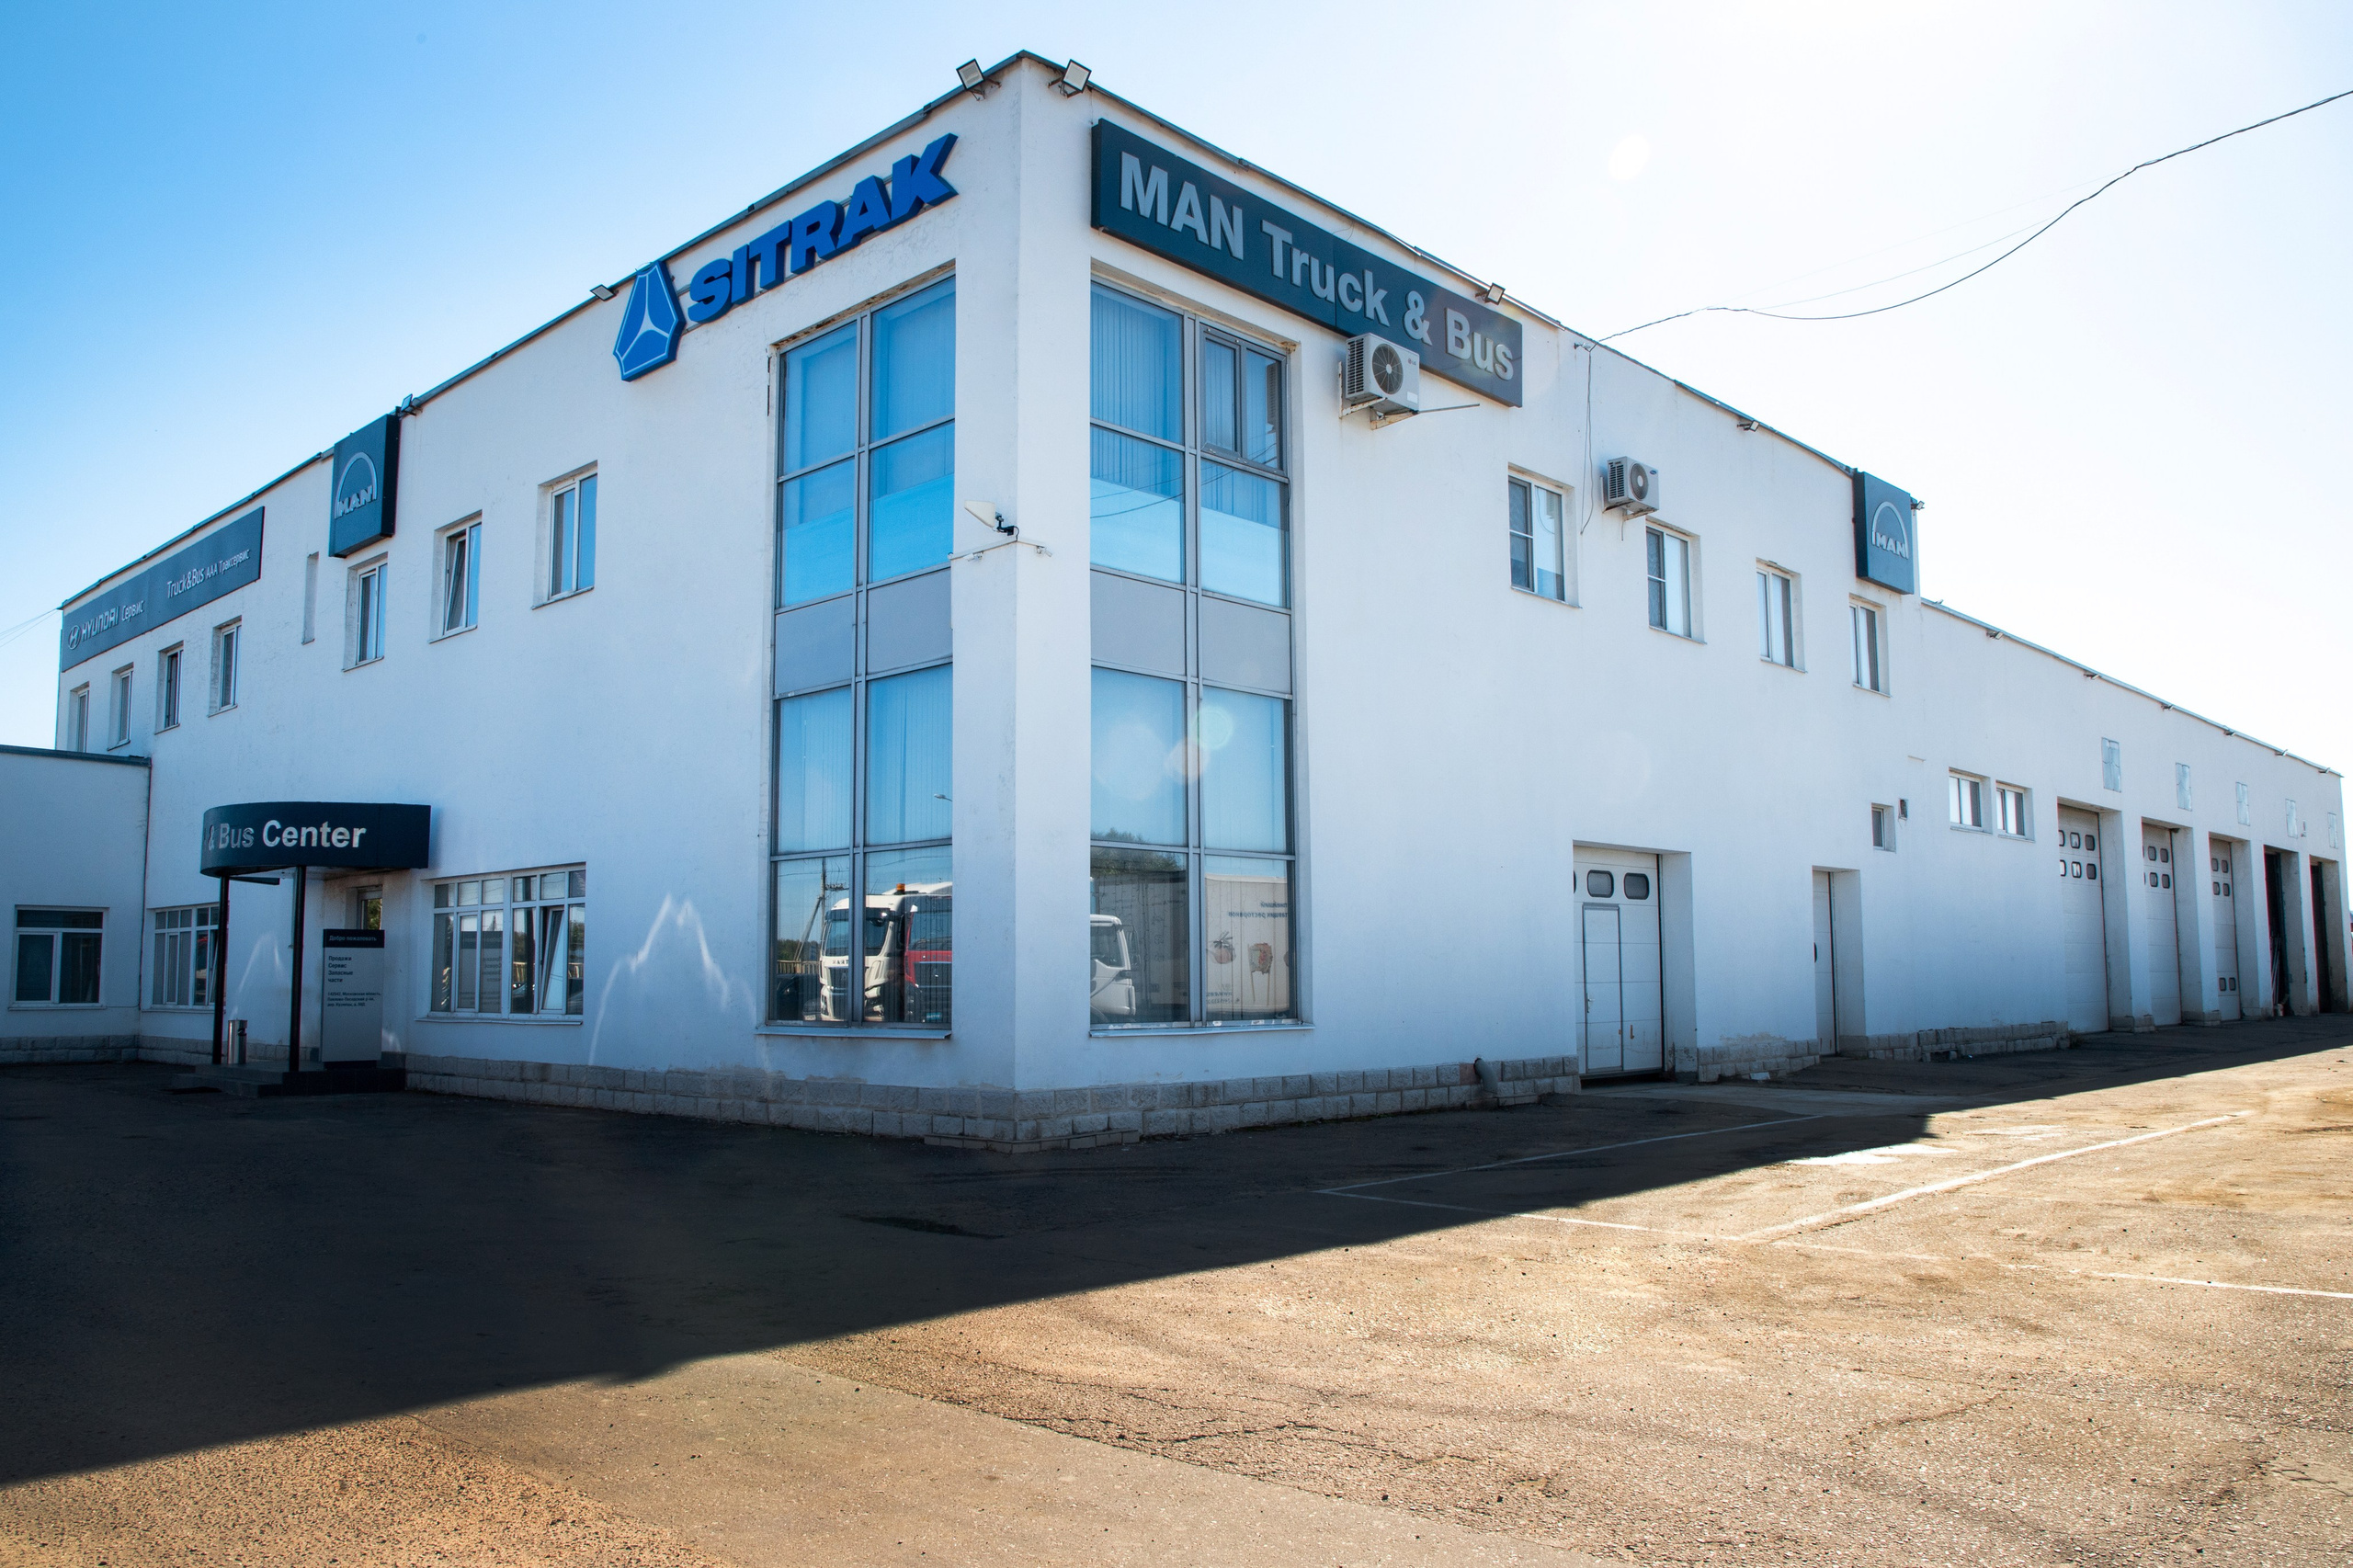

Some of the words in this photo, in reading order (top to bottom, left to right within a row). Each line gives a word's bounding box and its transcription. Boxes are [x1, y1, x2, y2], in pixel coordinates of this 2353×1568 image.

[688, 132, 959, 324] SITRAK
[1120, 151, 1244, 261] MAN
[1261, 220, 1390, 327] Truck
[1404, 290, 1432, 346] &
[1445, 307, 1515, 381] Bus
[337, 485, 373, 517] MAN
[1875, 532, 1905, 559] MAN
[167, 568, 205, 598] Truck&Bus
[80, 607, 119, 642] HYUNDAI
[121, 600, 145, 622] Сервис
[208, 824, 215, 851] &
[219, 823, 255, 849] Bus
[263, 820, 367, 848] Center
